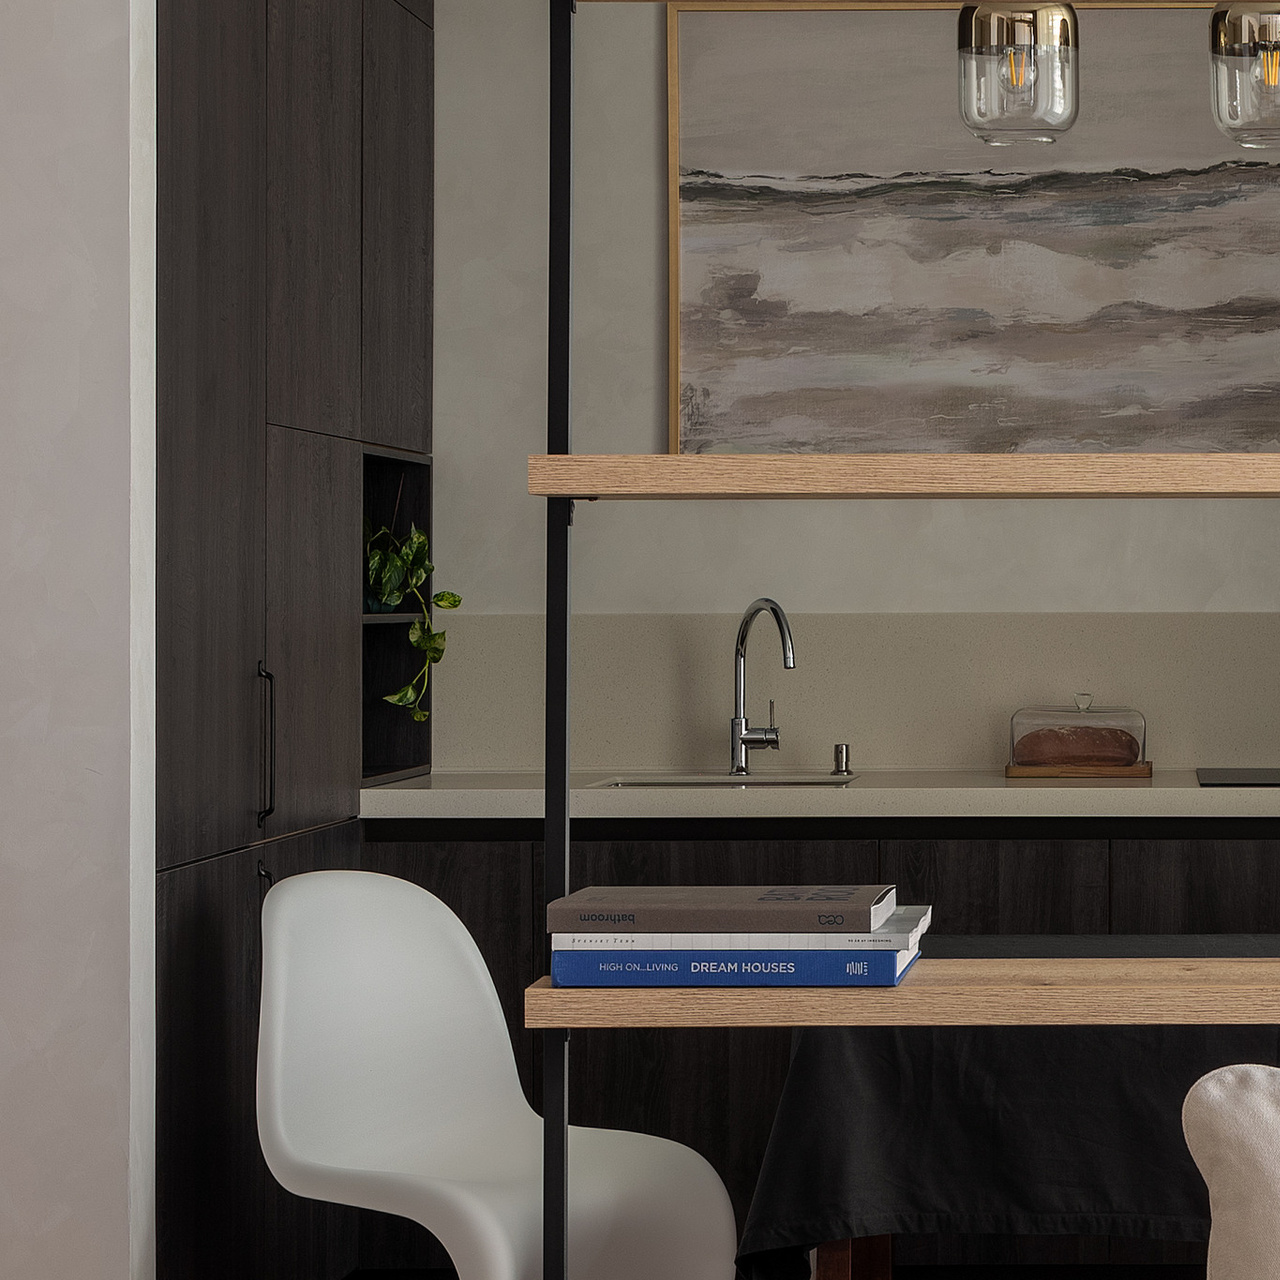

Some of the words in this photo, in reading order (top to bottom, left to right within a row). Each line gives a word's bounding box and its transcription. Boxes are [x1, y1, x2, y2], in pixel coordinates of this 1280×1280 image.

[579, 913, 635, 925] bathroom
[599, 962, 623, 972] HIGH
[690, 962, 738, 973] DREAM
[741, 962, 795, 973] HOUSES
